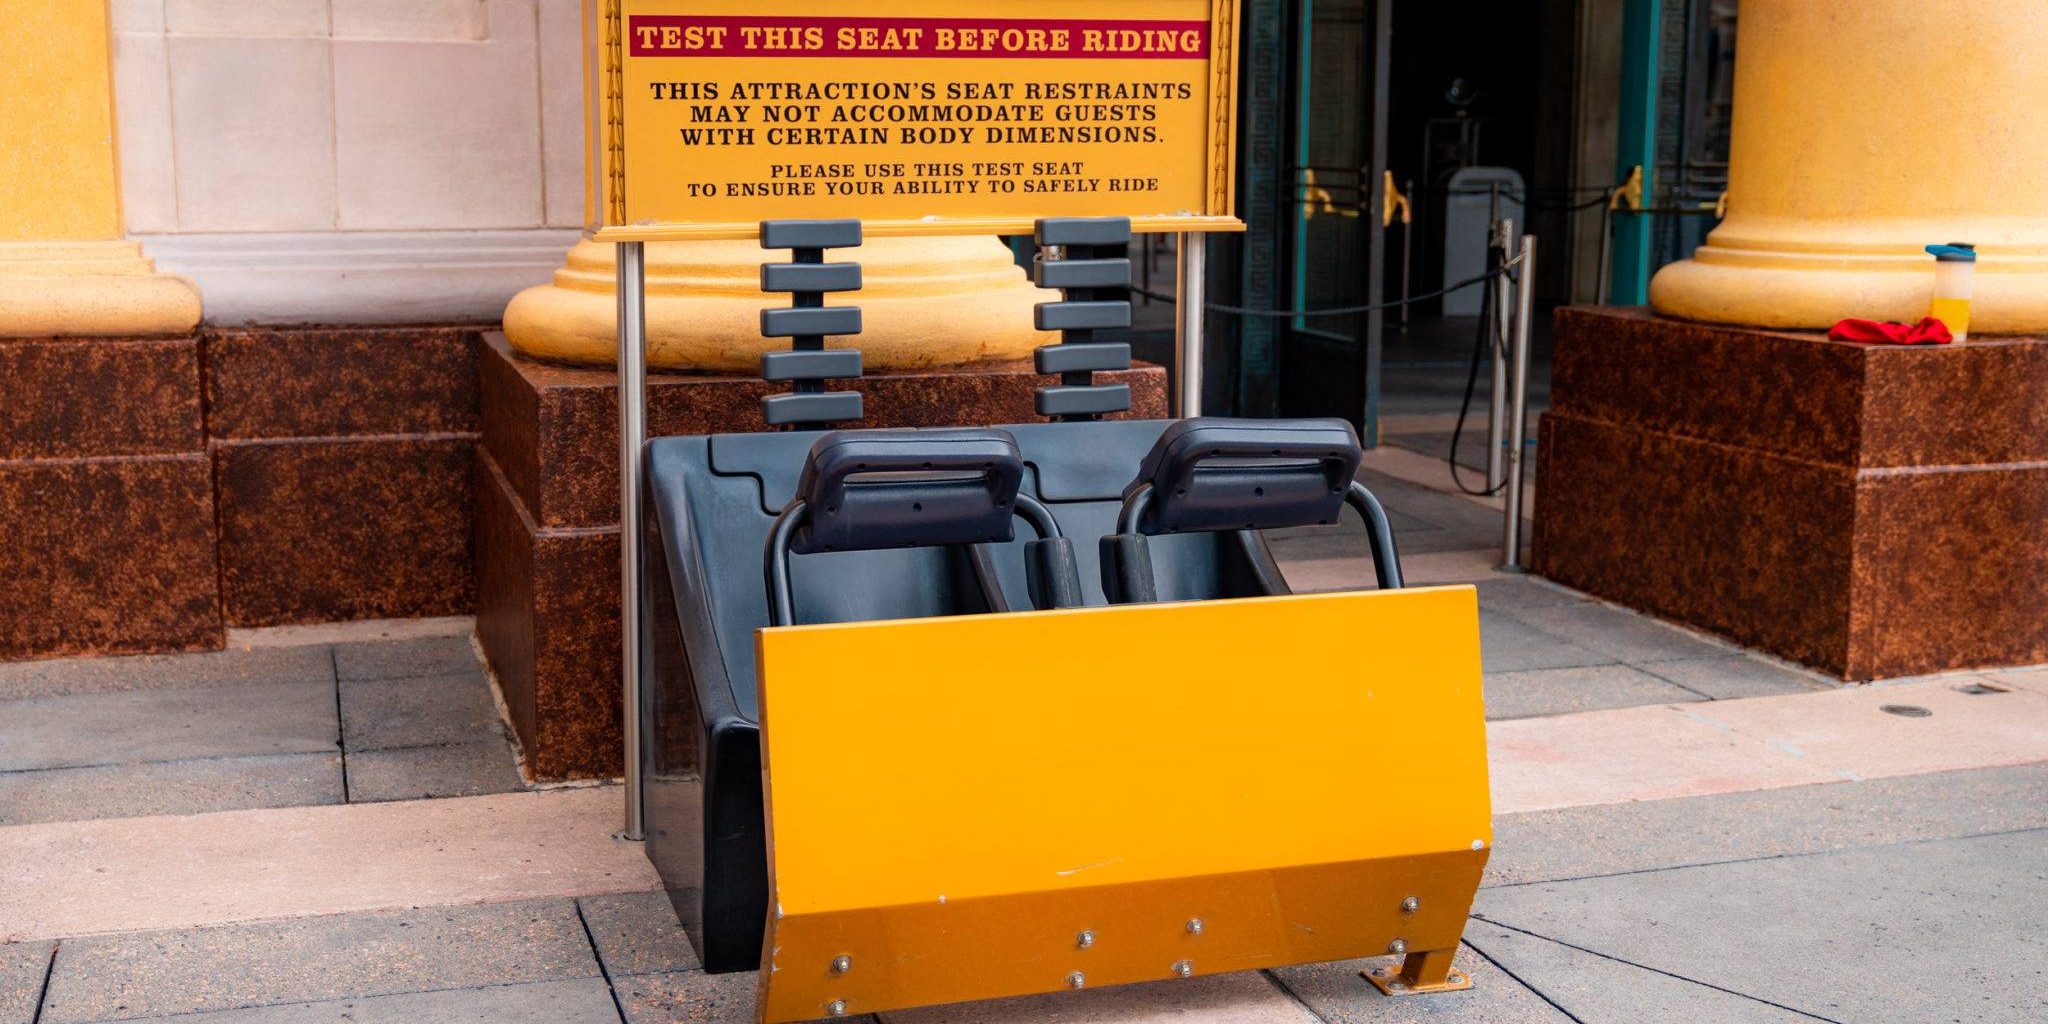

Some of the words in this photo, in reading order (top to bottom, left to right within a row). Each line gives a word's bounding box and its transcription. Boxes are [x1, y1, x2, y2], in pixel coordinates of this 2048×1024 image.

[637, 27, 726, 49] TEST
[741, 28, 823, 49] THIS
[838, 28, 922, 49] SEAT
[936, 29, 1069, 51] BEFORE
[1083, 30, 1200, 51] RIDING
[650, 83, 718, 100] THIS
[730, 83, 935, 100] ATTRACTION'S
[947, 83, 1013, 99] SEAT
[1025, 83, 1191, 99] RESTRAINTS
[690, 106, 750, 122] MAY
[763, 105, 820, 122] NOT
[831, 105, 1043, 122] ACCOMMODATE
[1056, 105, 1155, 121] GUESTS
[680, 129, 755, 145] WITH
[767, 128, 888, 145] CERTAIN
[901, 127, 974, 144] BODY
[986, 127, 1163, 143] DIMENSIONS.
[771, 164, 854, 178] PLEASE
[864, 164, 904, 177] USE
[914, 163, 963, 176] THIS
[972, 163, 1024, 175] TEST
[1033, 163, 1083, 175] SEAT
[688, 184, 716, 197] TO
[726, 183, 815, 196] ENSURE
[825, 182, 884, 195] YOUR
[893, 181, 979, 194] ABILITY
[988, 180, 1014, 193] TO
[1024, 179, 1099, 192] SAFELY
[1109, 179, 1157, 191] RIDE
